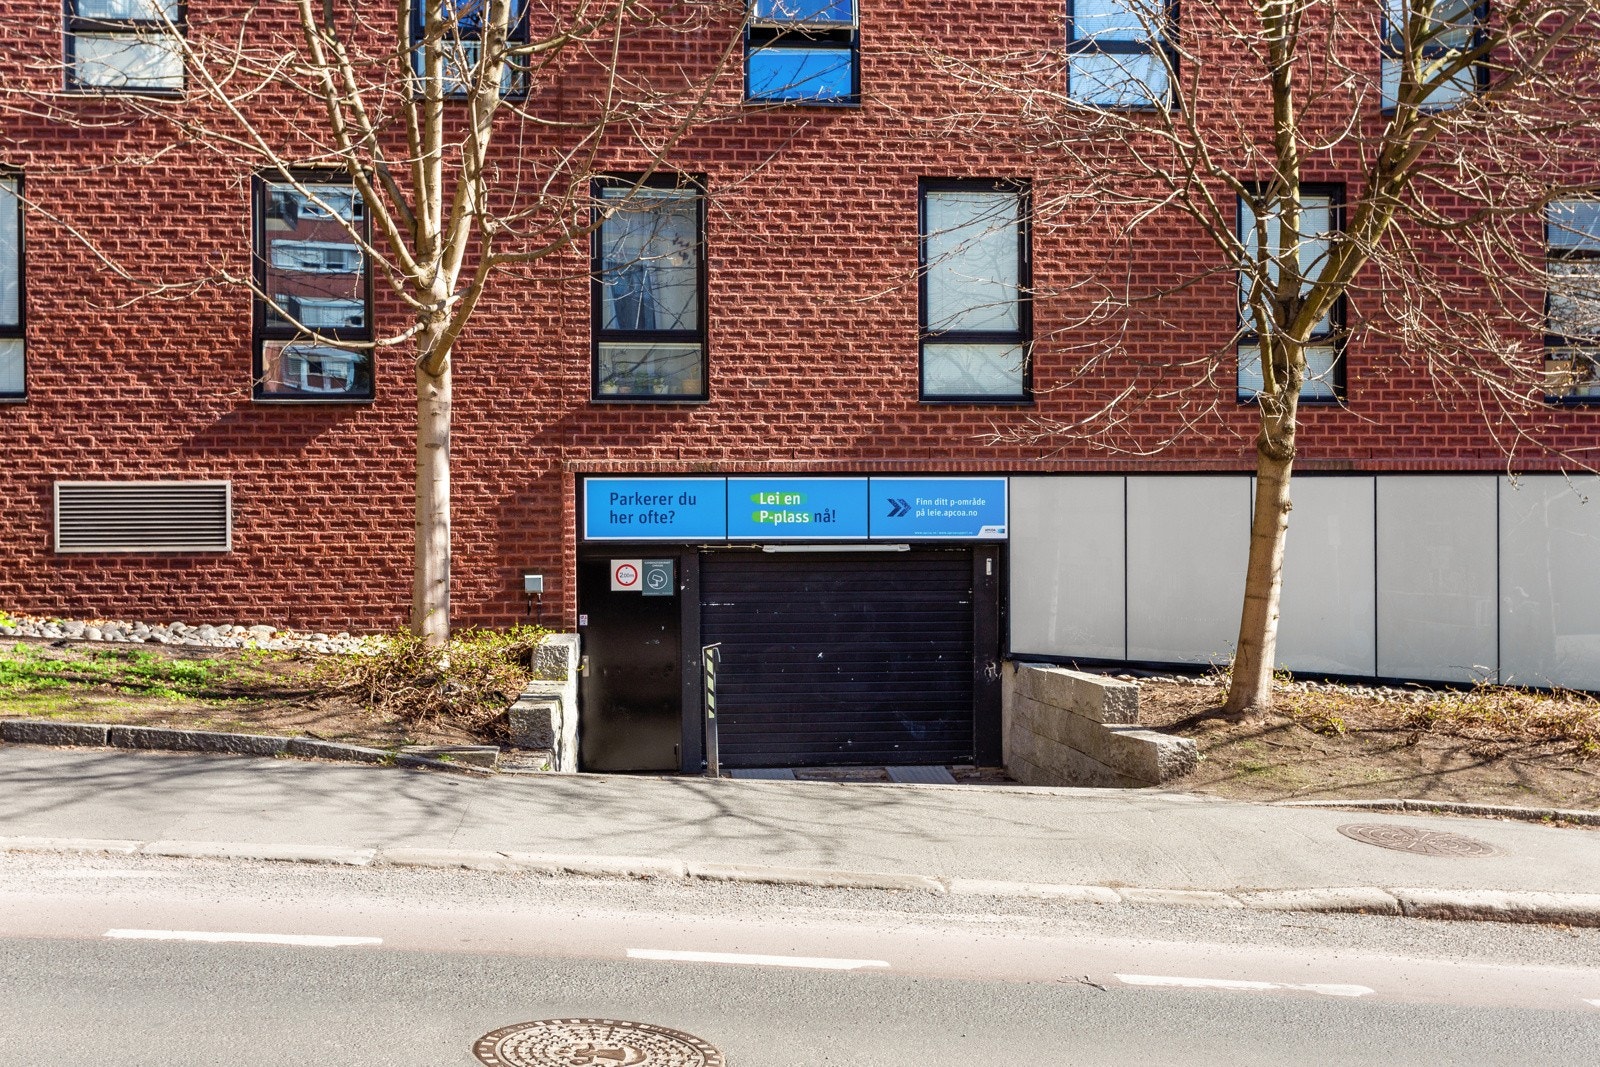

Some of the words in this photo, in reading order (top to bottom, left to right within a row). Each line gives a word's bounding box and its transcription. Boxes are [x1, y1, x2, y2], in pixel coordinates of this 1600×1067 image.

[610, 492, 674, 506] Parkerer
[678, 492, 696, 506] du
[760, 492, 780, 505] Lei
[784, 494, 801, 505] en
[916, 498, 932, 506] Finn
[934, 498, 948, 506] ditt
[950, 498, 986, 507] p-område
[610, 510, 634, 524] her
[638, 510, 676, 524] ofte?
[760, 510, 810, 526] P-plass
[814, 508, 836, 523] nå!
[916, 508, 926, 518] på
[927, 508, 978, 518] leie.apcoa.no
